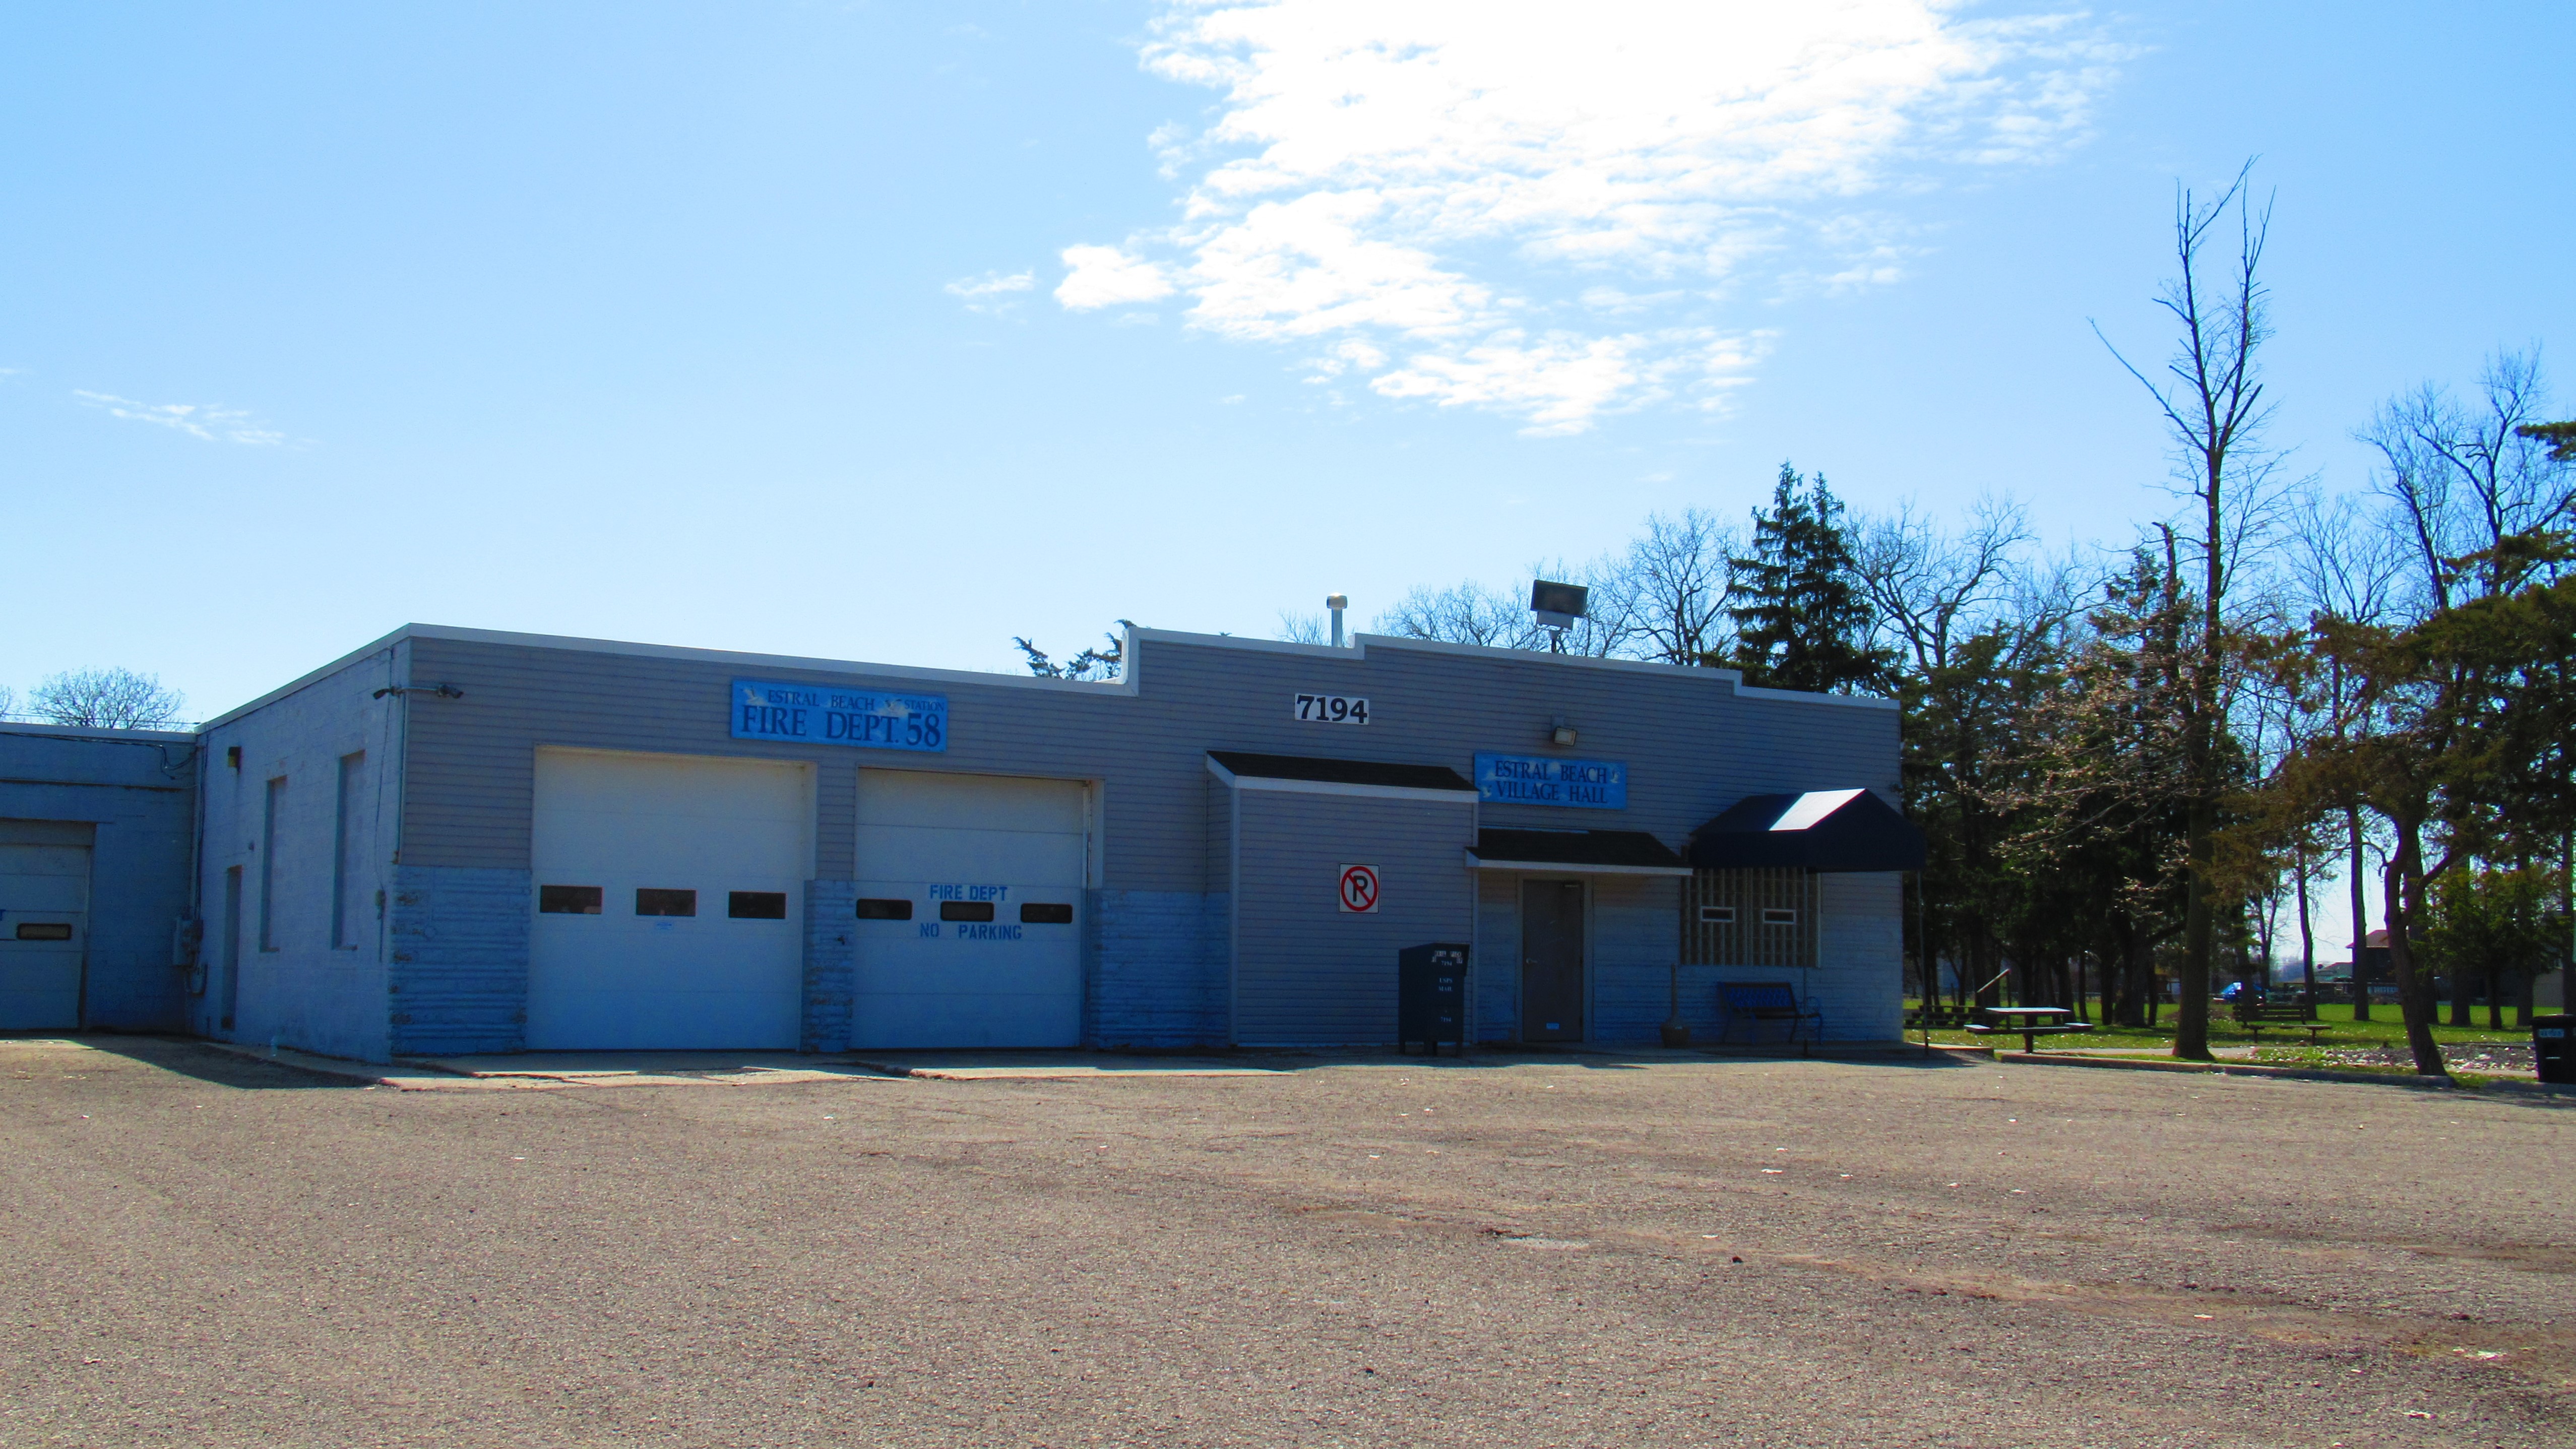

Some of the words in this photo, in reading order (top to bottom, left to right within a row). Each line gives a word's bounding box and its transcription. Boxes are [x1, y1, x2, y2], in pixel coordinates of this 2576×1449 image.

[768, 689, 820, 707] ESTRAL
[831, 695, 874, 711] BEACH
[904, 700, 945, 712] STATION
[1297, 695, 1367, 723] 7194
[742, 706, 806, 736] FIRE
[826, 711, 899, 743] DEPT.
[907, 713, 941, 747] 58
[1495, 761, 1551, 780] ESTRAL
[1560, 765, 1607, 784] BEACH
[1496, 780, 1560, 800] VILLAGE
[1569, 785, 1607, 803] HALL
[930, 885, 963, 900] FIRE
[970, 886, 1008, 901] DEPT
[920, 923, 939, 937] NO
[959, 924, 1022, 939] PARKING
